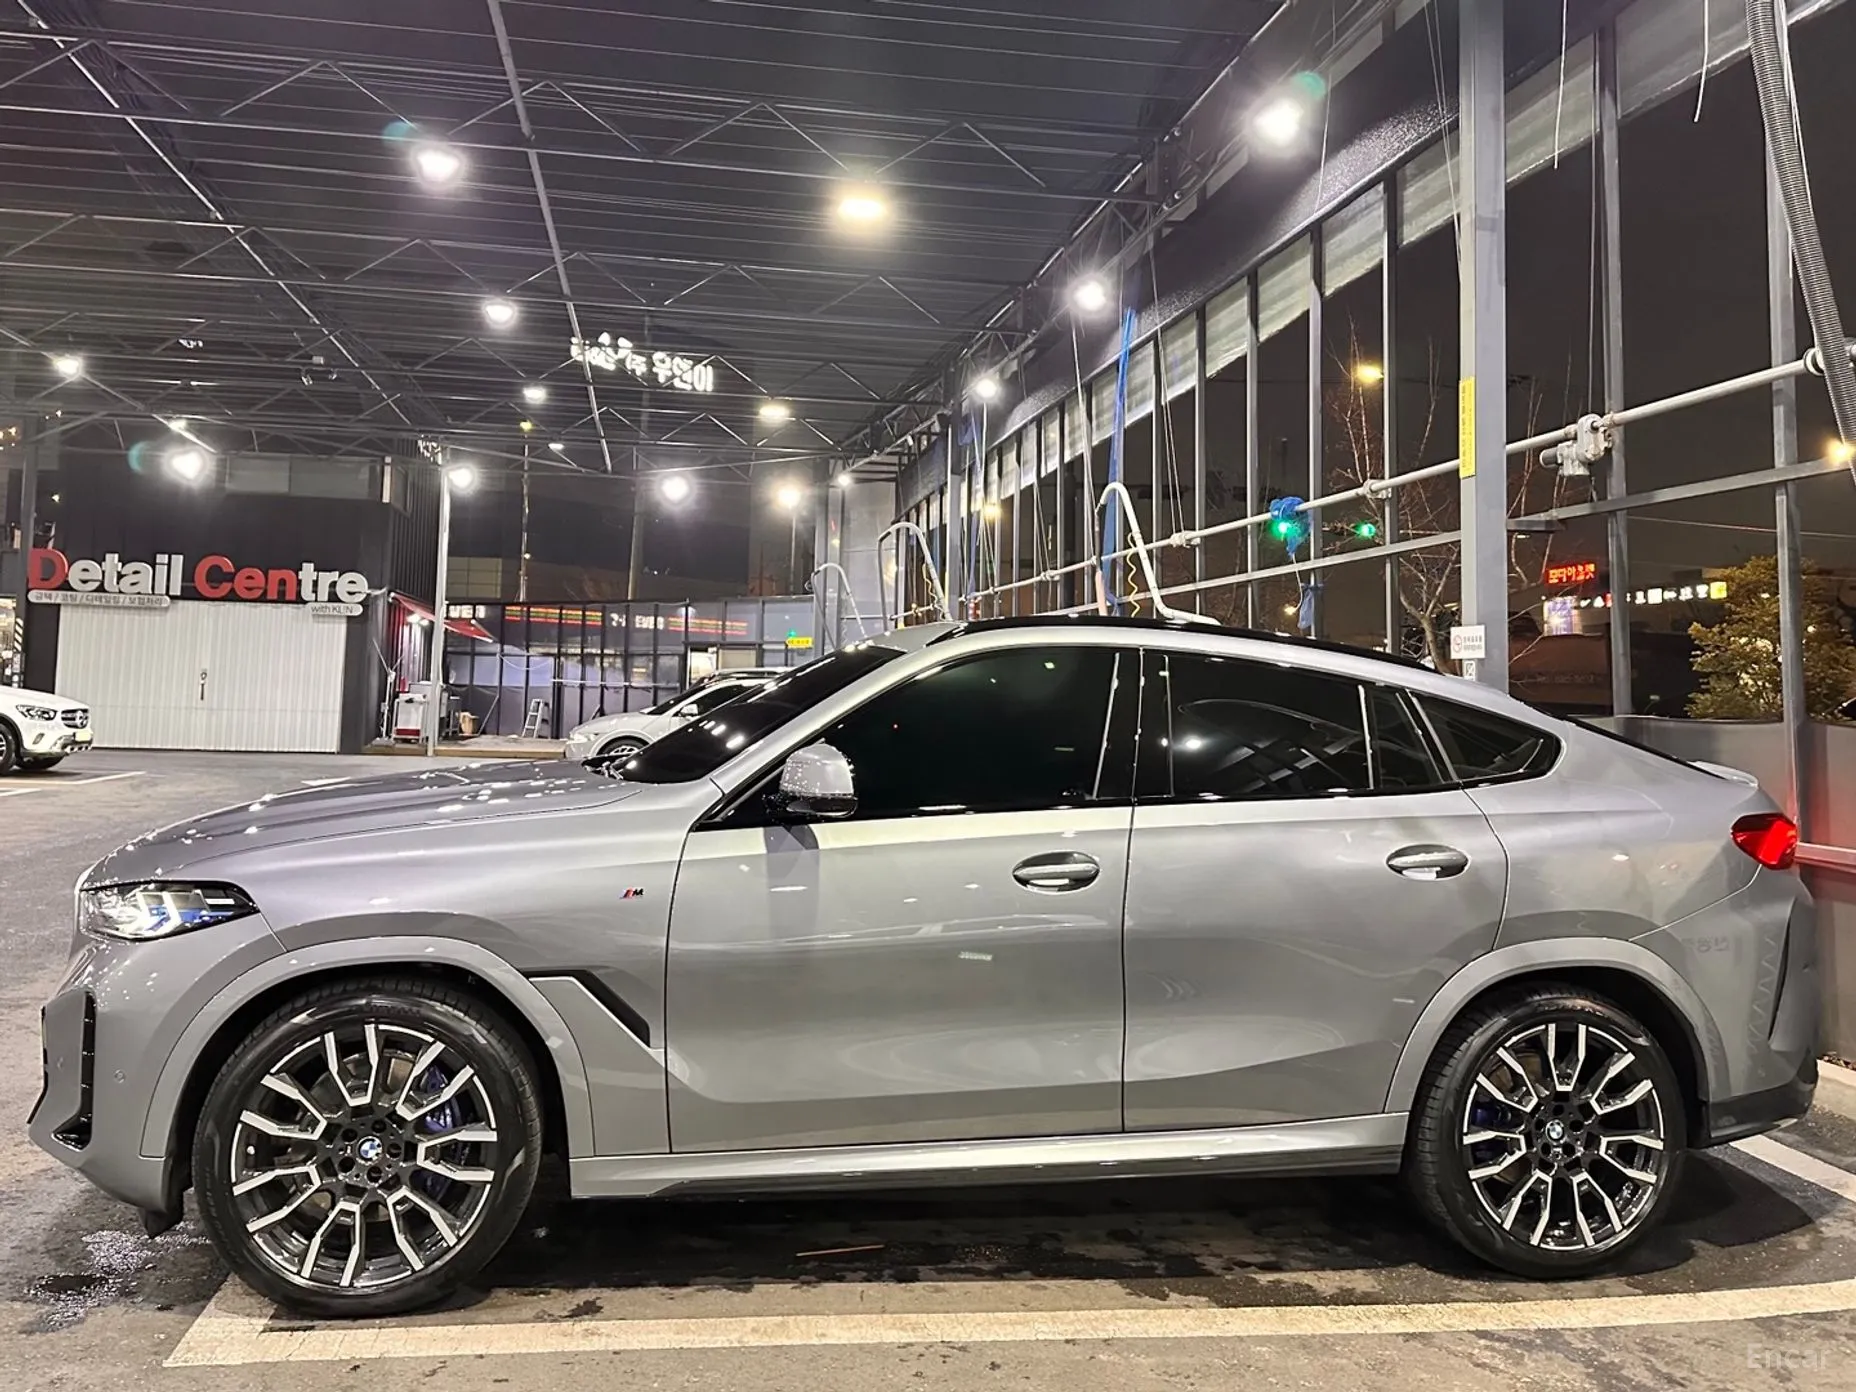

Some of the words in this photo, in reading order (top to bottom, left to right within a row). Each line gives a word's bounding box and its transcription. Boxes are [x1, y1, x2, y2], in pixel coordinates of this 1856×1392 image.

[27, 547, 183, 596] Detail
[194, 555, 368, 604] Centre
[311, 604, 331, 613] with
